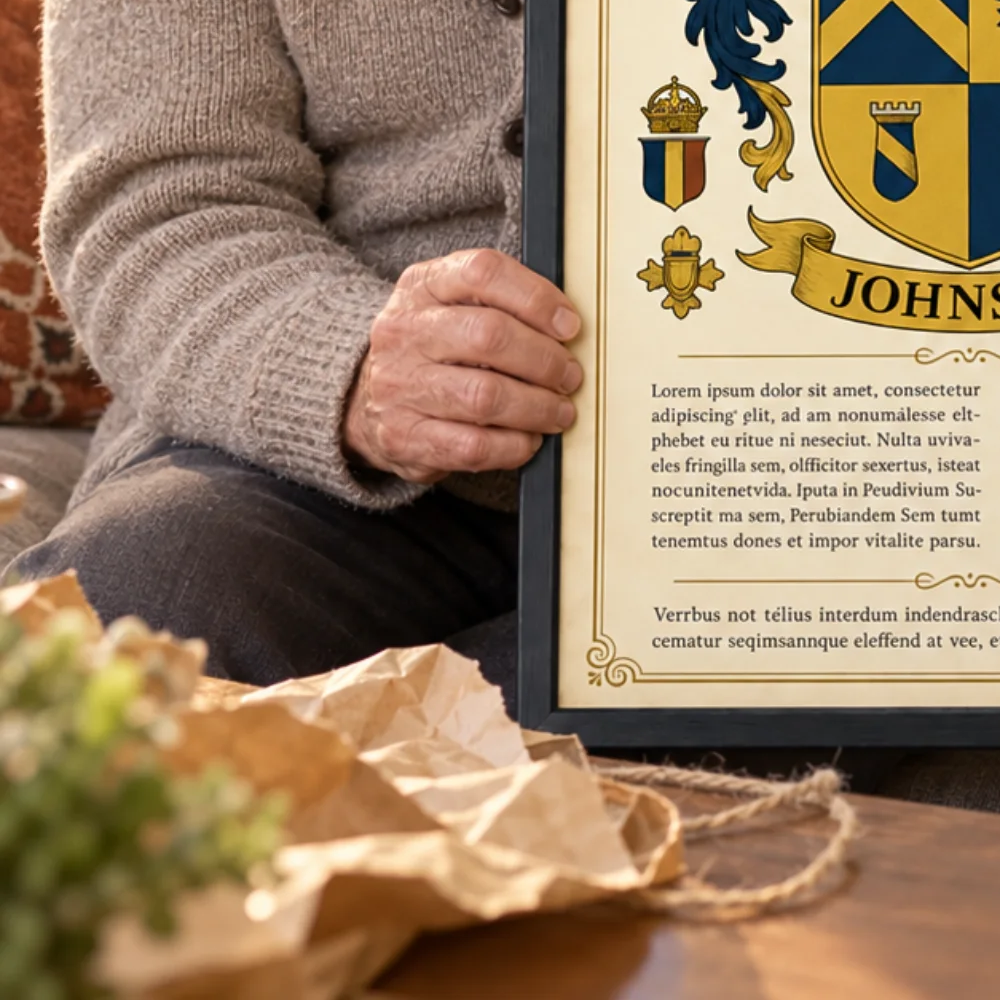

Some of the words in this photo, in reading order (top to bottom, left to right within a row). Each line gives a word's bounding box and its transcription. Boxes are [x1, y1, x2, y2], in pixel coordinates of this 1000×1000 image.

[651, 383, 703, 399] Lorem
[707, 382, 756, 403] ipsum
[759, 381, 804, 398] dolor
[807, 382, 827, 398] sit
[832, 384, 879, 399] amet,
[883, 384, 982, 398] consectetur
[780, 406, 801, 423] ad
[806, 411, 832, 423] am
[651, 431, 705, 453] phebet
[710, 436, 730, 448] eu
[779, 431, 796, 448] ni
[800, 431, 872, 448] neseciut.
[927, 431, 981, 448] uviva-
[650, 456, 681, 473] eles
[684, 456, 747, 478] fringilla
[750, 461, 786, 475] sem,
[861, 459, 932, 474] sexertus,
[937, 456, 981, 473] isteat
[796, 482, 838, 502] Iputa
[842, 481, 859, 498] in
[862, 480, 950, 498] Peudivium
[955, 481, 982, 498] Su-
[650, 506, 714, 527] screptit
[718, 511, 743, 523] ma
[747, 511, 786, 525] sem,
[789, 506, 896, 523] Perubiandem
[940, 509, 981, 523] tumt
[651, 534, 729, 549] tenemtus
[732, 532, 783, 549] dones
[786, 535, 803, 549] et
[808, 532, 860, 553] impor
[864, 531, 925, 549] vitalite
[929, 536, 981, 553] parsu.
[653, 605, 722, 623] Verrbus
[727, 608, 757, 623] not
[818, 605, 898, 623] interdum
[651, 635, 723, 649] cematur
[926, 635, 943, 649] at
[949, 636, 984, 651] vee,
